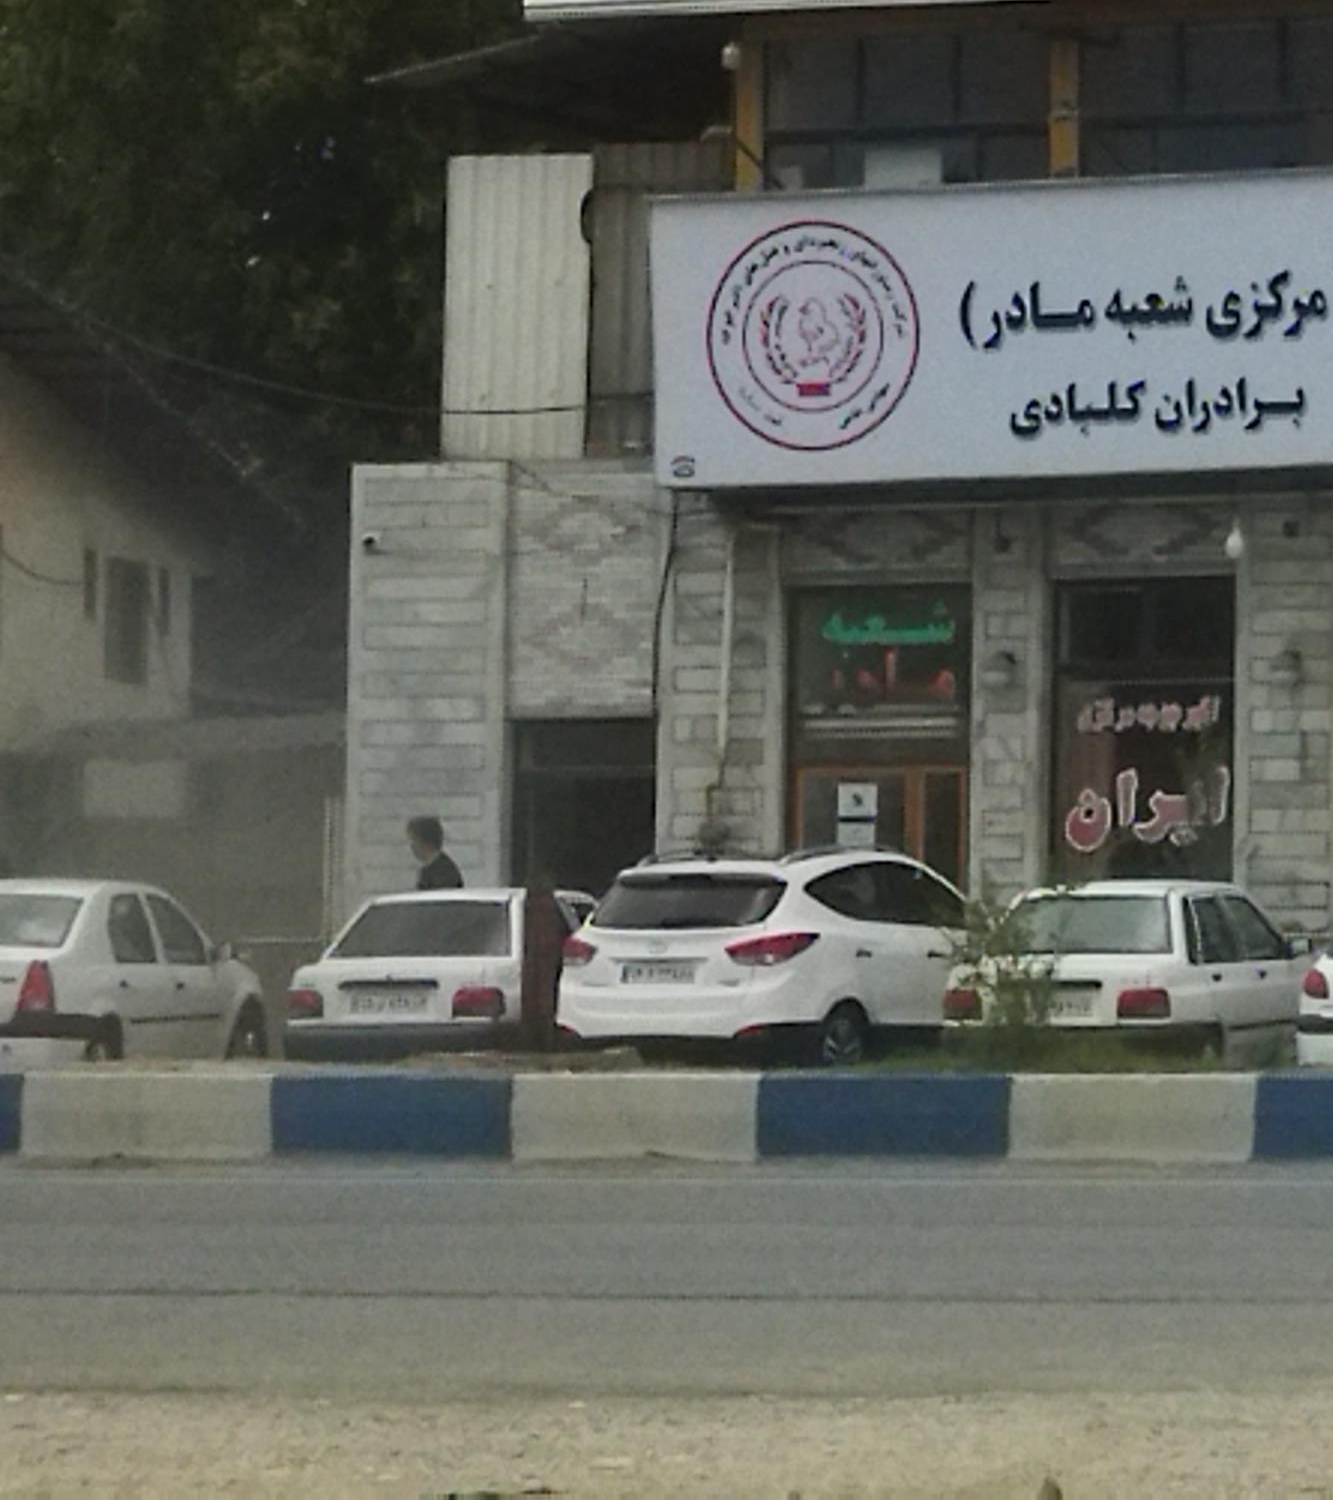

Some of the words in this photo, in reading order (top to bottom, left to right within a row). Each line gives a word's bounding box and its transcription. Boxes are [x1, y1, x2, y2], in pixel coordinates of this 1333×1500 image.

[959, 280, 1097, 351] مادر)
[1103, 275, 1195, 343] شعبه
[1009, 380, 1148, 438] کلبادی
[1154, 377, 1307, 434] برادران
[1065, 764, 1231, 853] ایران
